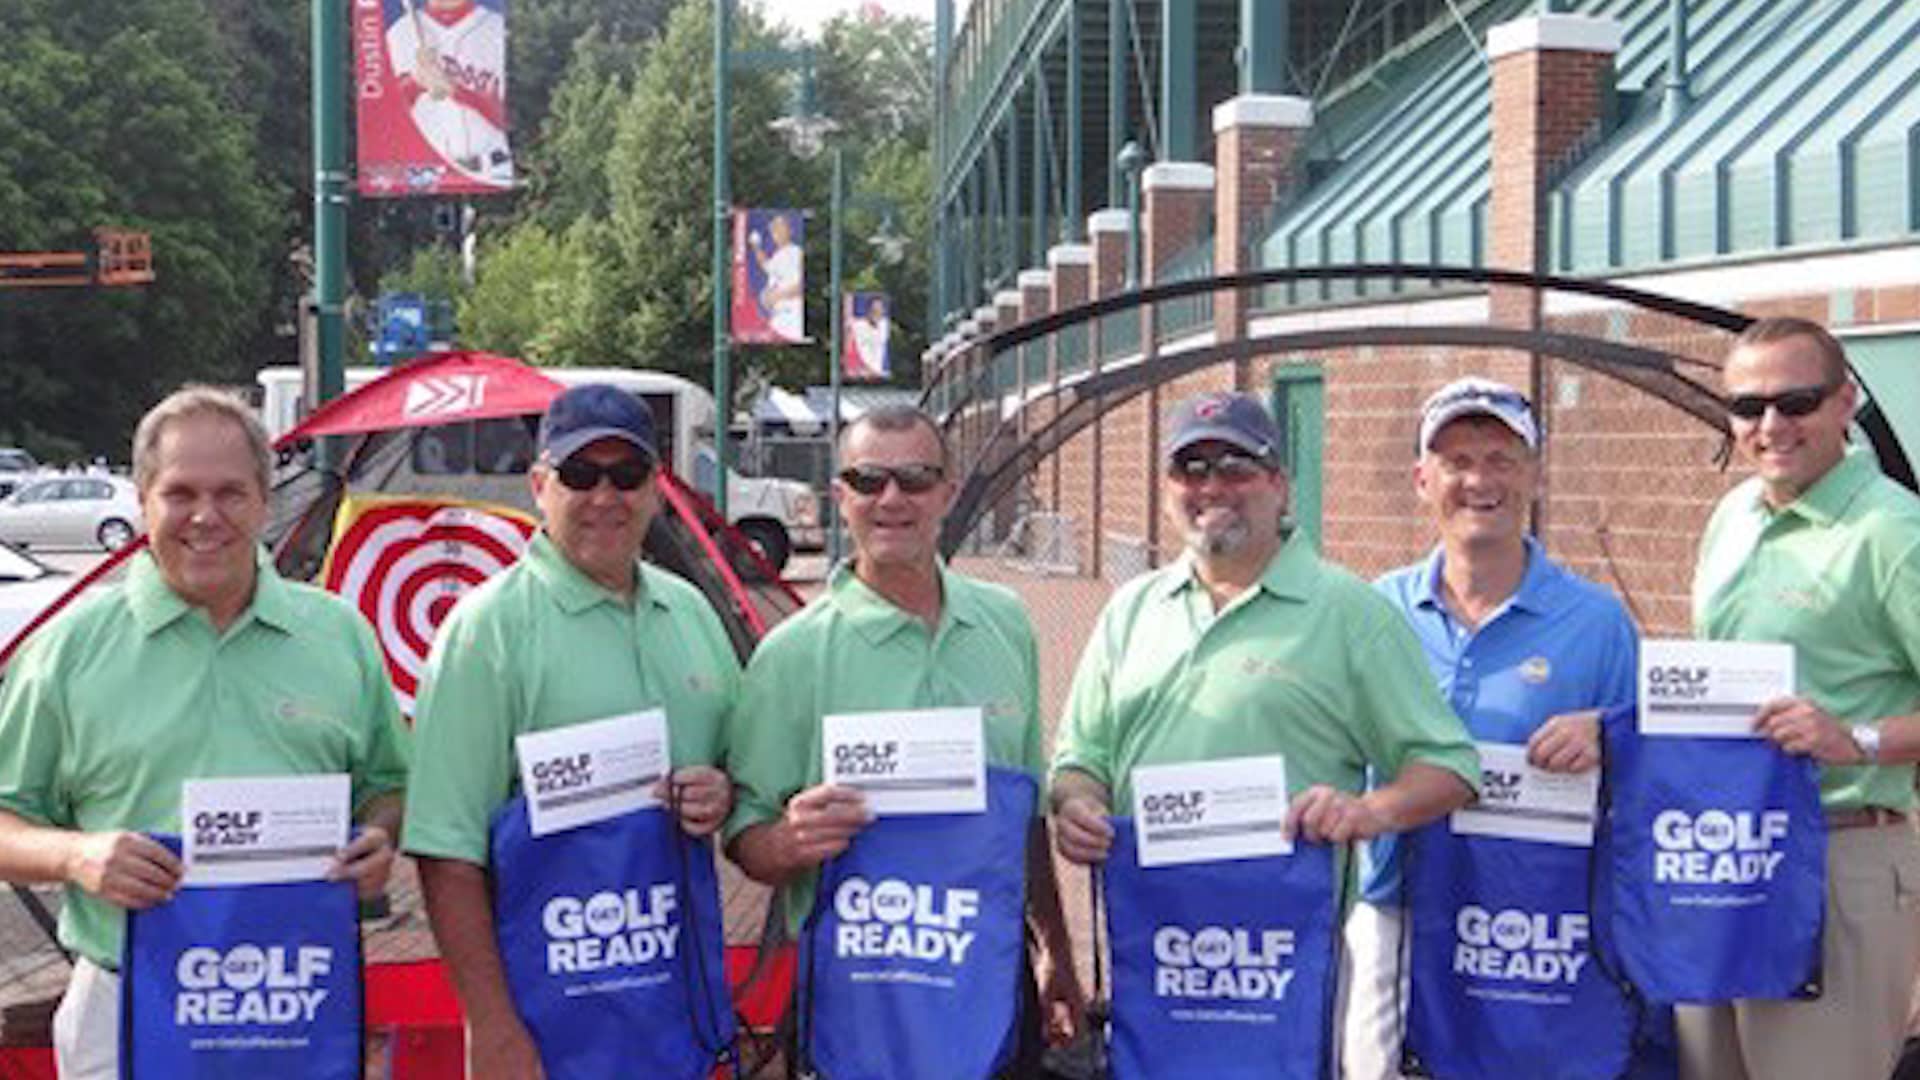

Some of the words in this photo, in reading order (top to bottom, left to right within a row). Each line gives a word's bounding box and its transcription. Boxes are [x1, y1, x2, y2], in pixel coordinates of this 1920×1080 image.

[359, 17, 383, 99] Dustin
[1649, 667, 1708, 683] GOLF
[1650, 686, 1708, 696] READY
[833, 742, 897, 759] GOLF
[533, 754, 590, 778] GOLF
[835, 762, 897, 774] READY
[1482, 770, 1522, 787] OLF
[537, 774, 592, 794] READY
[1144, 791, 1204, 810] GOLF
[195, 812, 260, 830] GOLF
[1653, 811, 1786, 850] GOLF
[197, 832, 258, 845] READY
[1655, 853, 1782, 882] READY
[544, 885, 675, 936] GOLF
[835, 878, 976, 928] GOLF
[838, 923, 972, 962] READY
[1457, 906, 1587, 950] GOLF
[548, 927, 677, 972] READY
[1155, 927, 1292, 966] GOLF
[177, 945, 330, 988] GOLF
[1453, 945, 1585, 982] READY
[1157, 968, 1292, 998] READY
[176, 990, 326, 1024] READY
